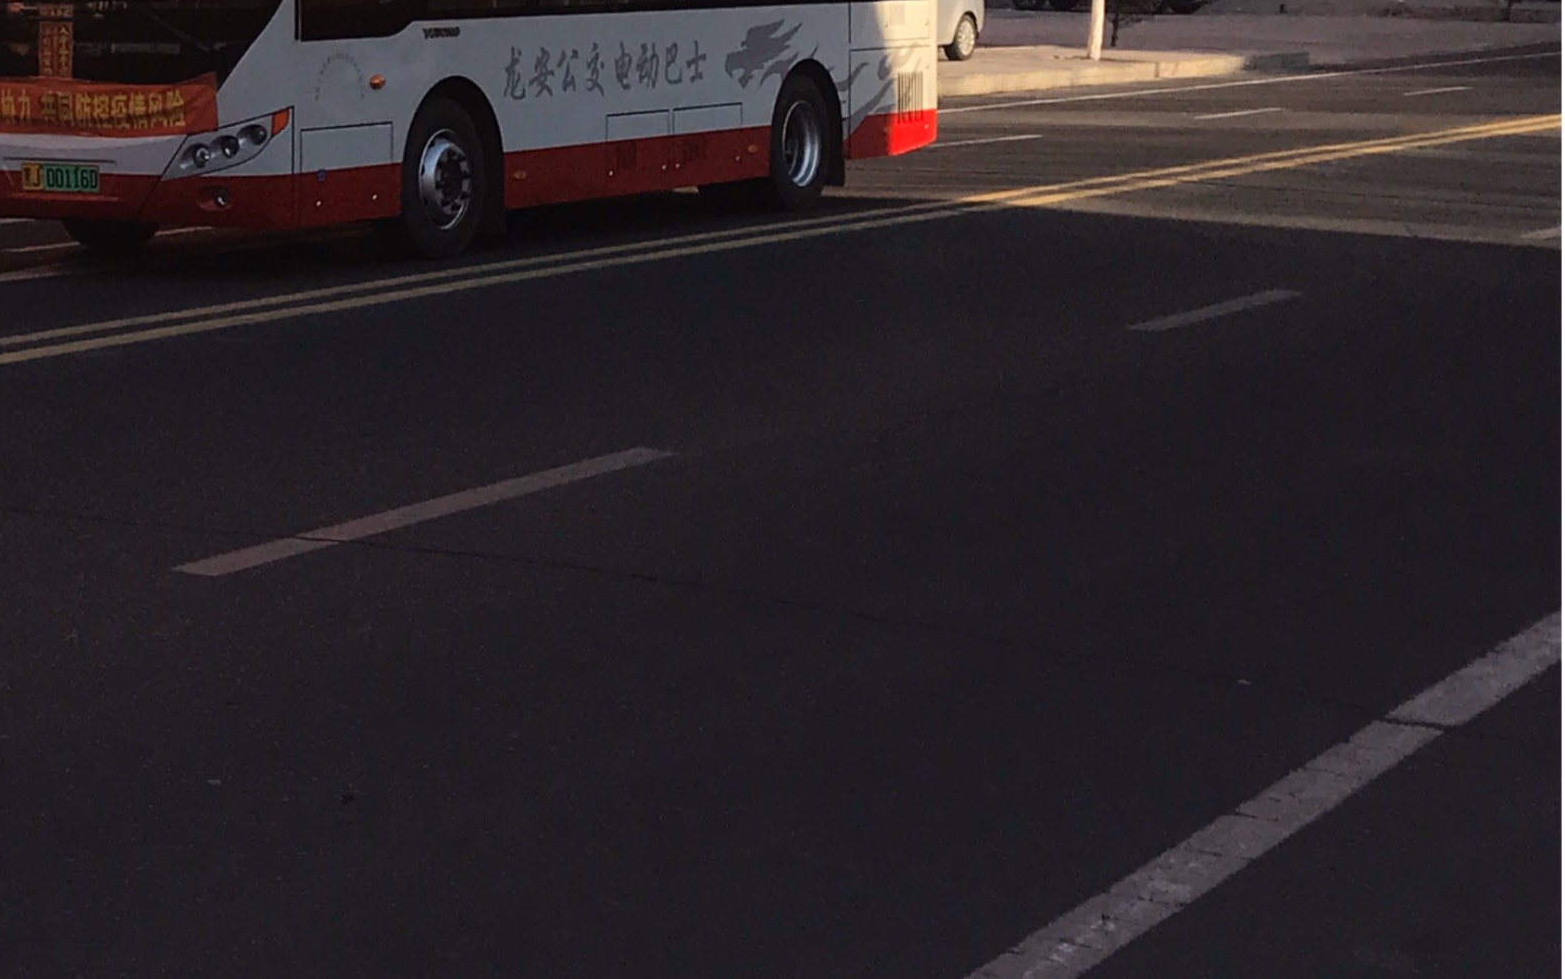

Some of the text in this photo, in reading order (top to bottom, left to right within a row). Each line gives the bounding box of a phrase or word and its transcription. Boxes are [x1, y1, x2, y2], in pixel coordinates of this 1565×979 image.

[503, 40, 708, 101] 龙安公交电动巴士
